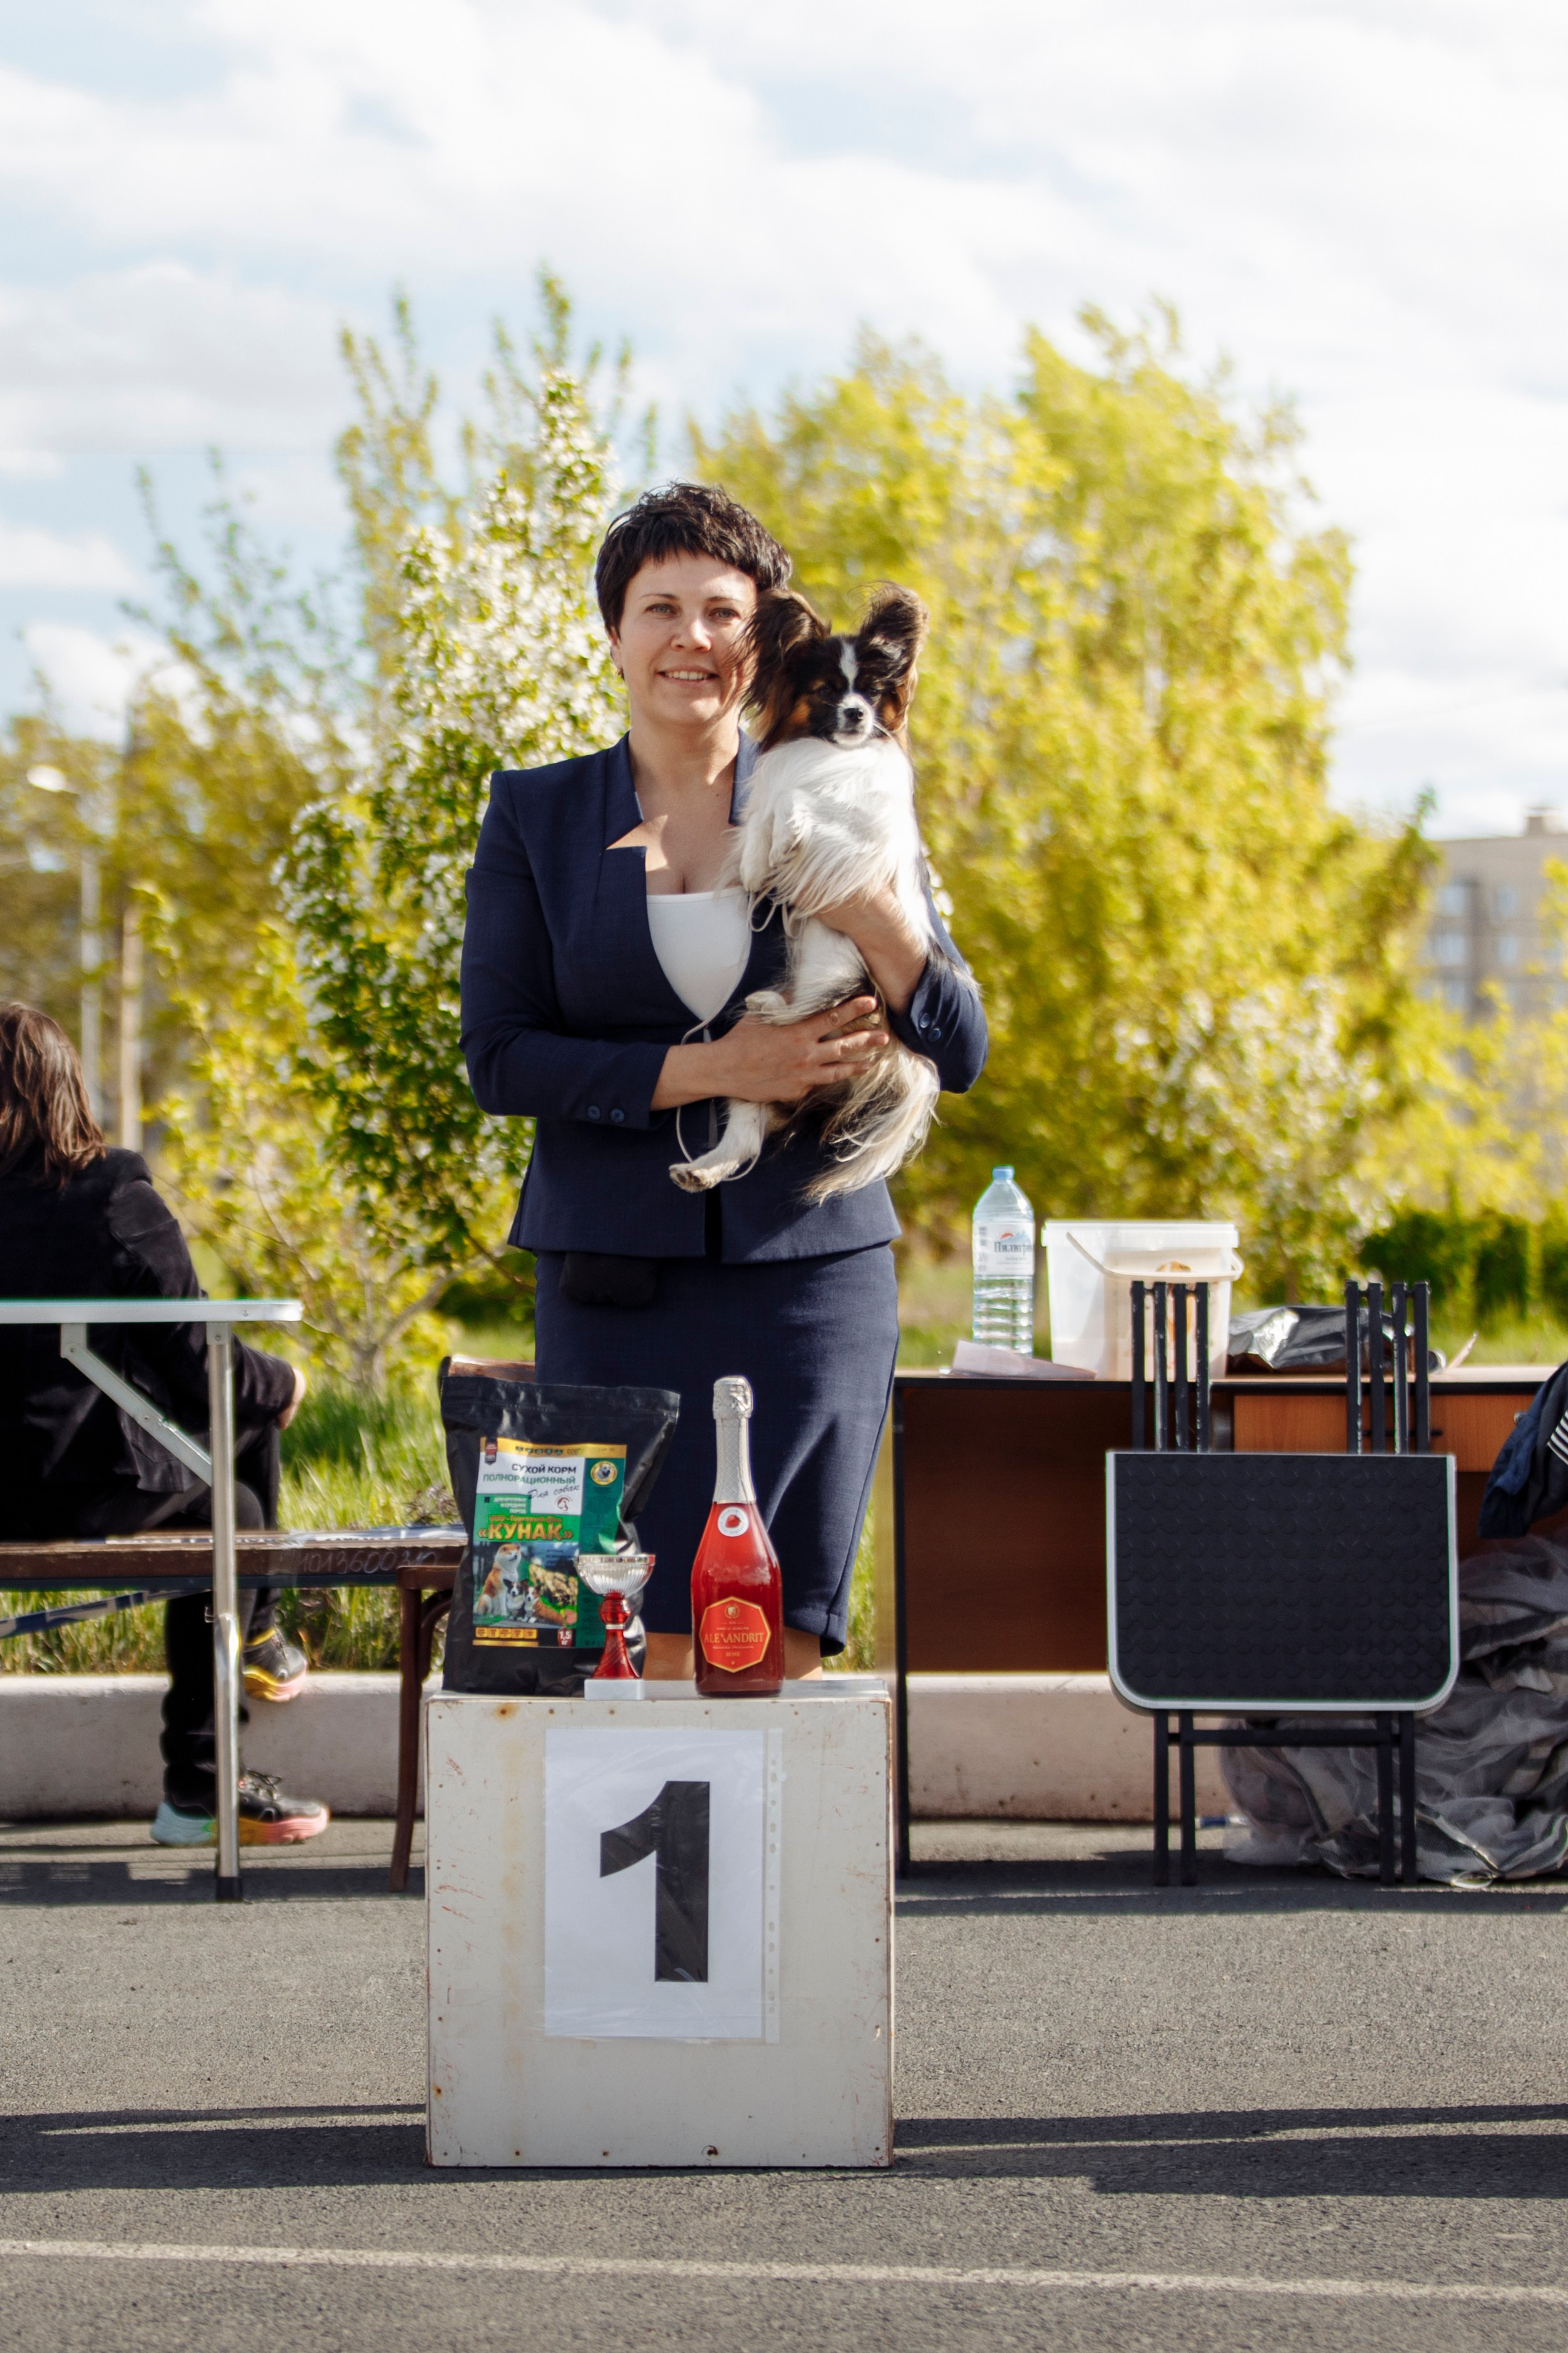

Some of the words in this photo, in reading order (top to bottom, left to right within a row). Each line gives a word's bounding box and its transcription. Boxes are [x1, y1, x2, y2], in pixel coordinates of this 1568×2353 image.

[994, 1241, 1033, 1256] Пилигри
[512, 1463, 545, 1474] СУХОЙ
[483, 1474, 575, 1485] ПОЛНОРАЦИОННЫЙ
[527, 1489, 549, 1499] Для
[553, 1484, 580, 1495] собак
[478, 1522, 573, 1540] «КУНАК»
[704, 1632, 764, 1643] ALEXANDRIT
[600, 1781, 710, 1982] 1
